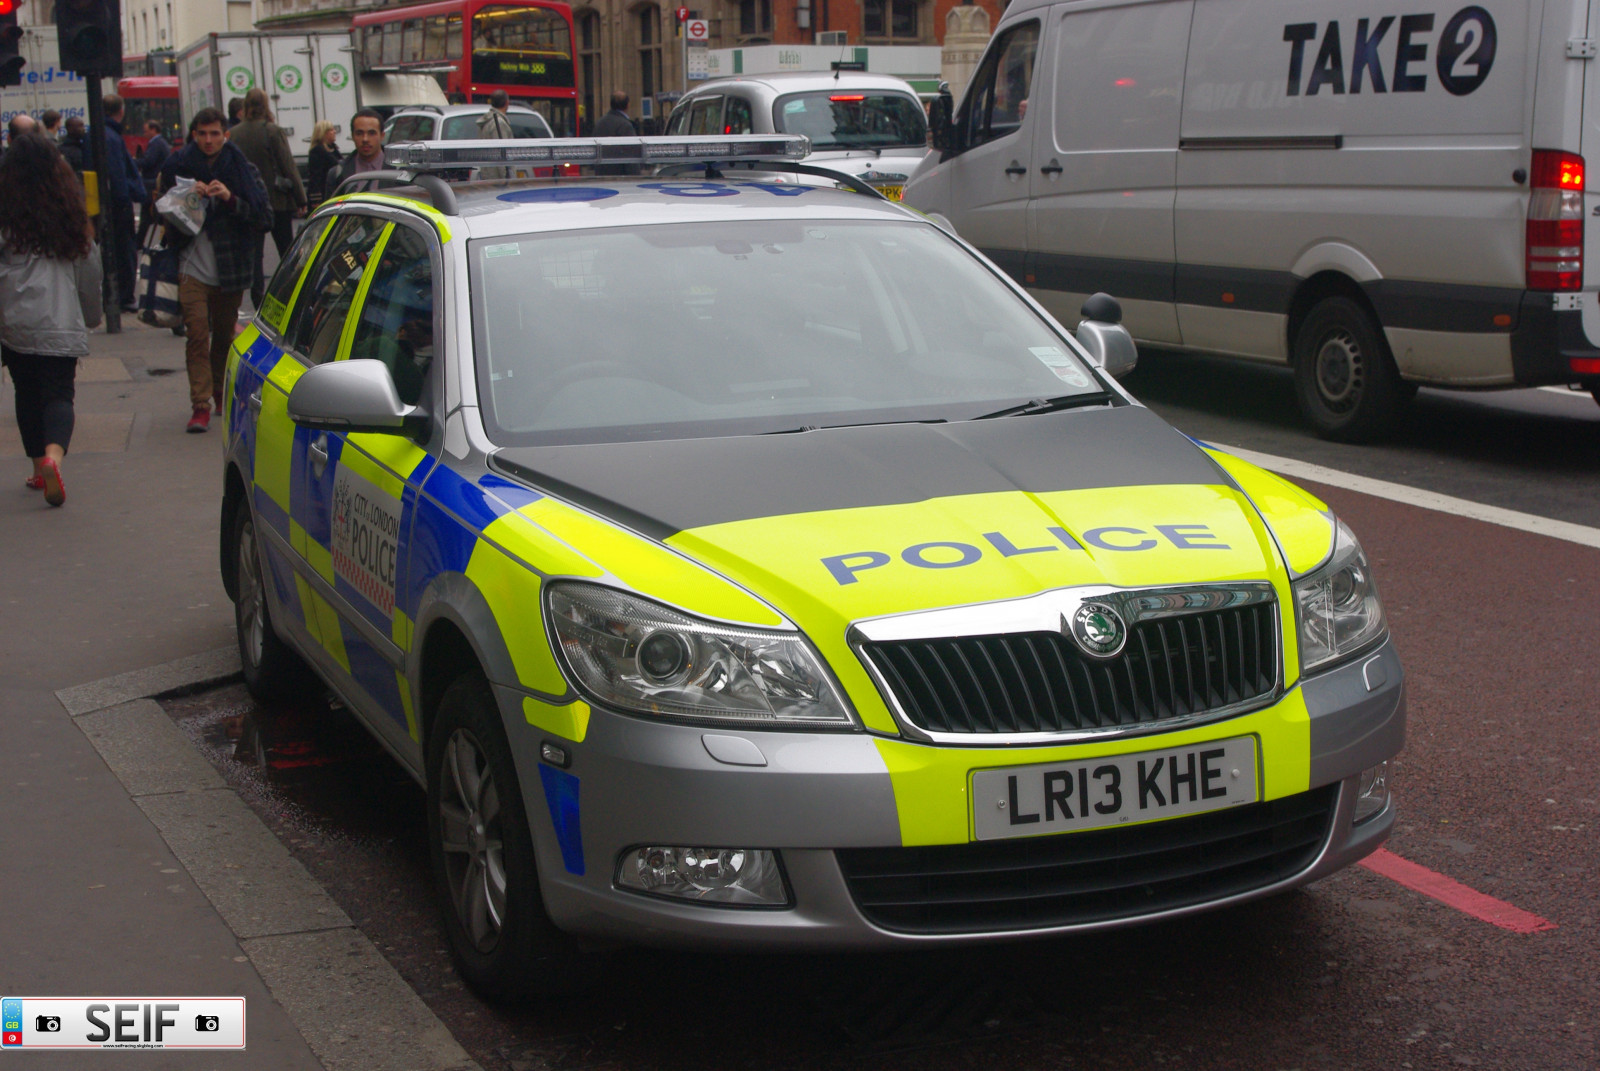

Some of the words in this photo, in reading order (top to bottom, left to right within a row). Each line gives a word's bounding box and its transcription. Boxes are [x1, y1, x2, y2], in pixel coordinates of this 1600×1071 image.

[679, 8, 686, 19] F
[1284, 13, 1435, 96] TAKE
[1450, 18, 1483, 77] 2
[354, 493, 369, 517] CITY
[370, 504, 399, 540] LONDON
[352, 518, 396, 589] POLICE
[820, 524, 1231, 586] POLICE
[1009, 764, 1122, 826] LR13
[1138, 748, 1227, 809] KHE
